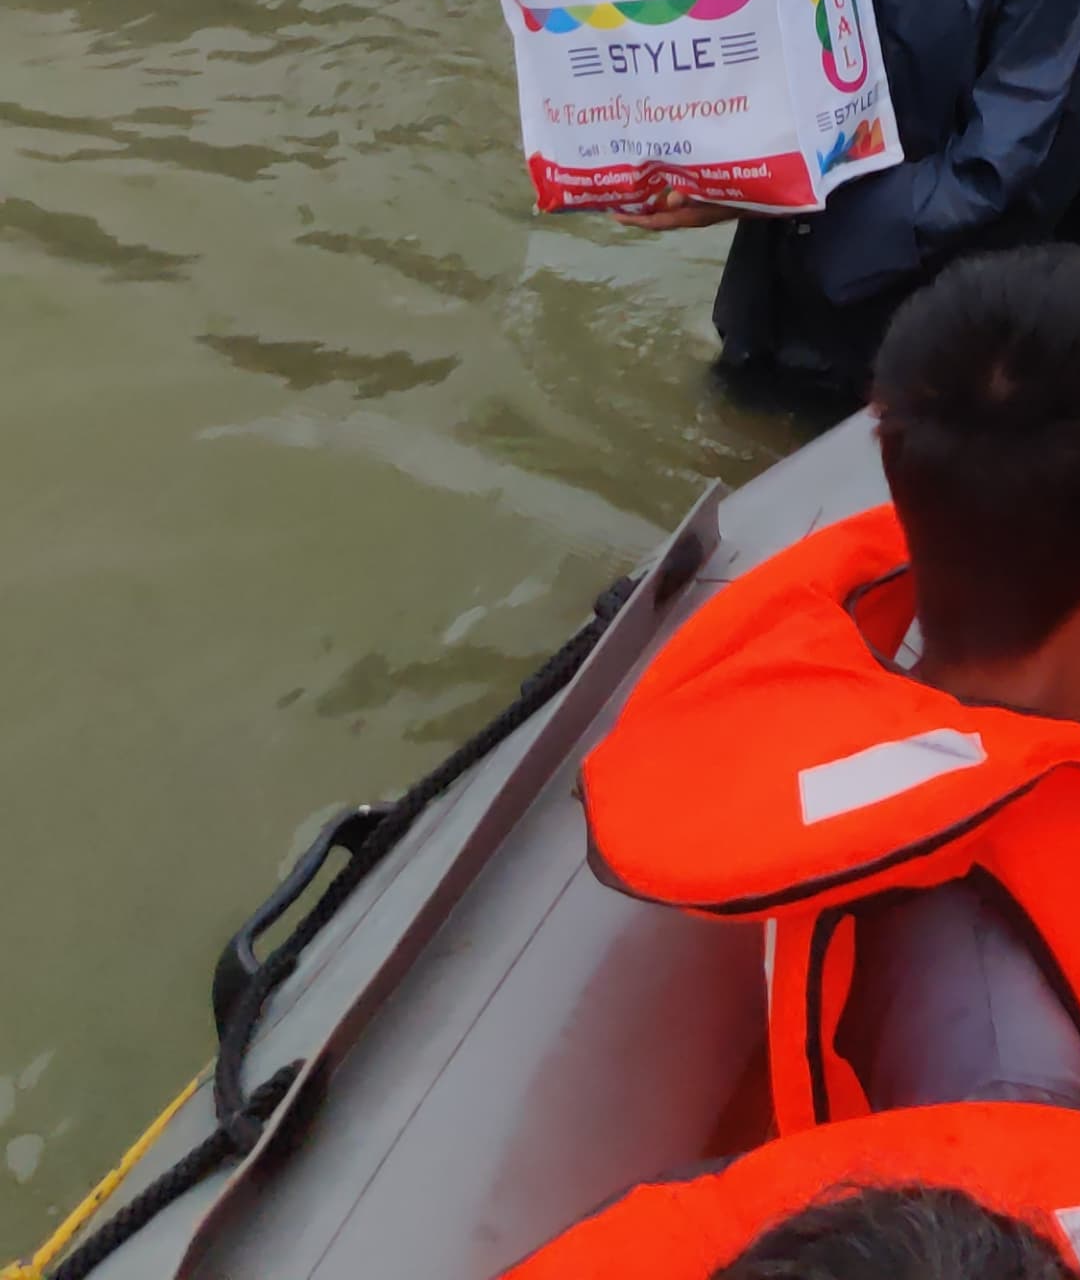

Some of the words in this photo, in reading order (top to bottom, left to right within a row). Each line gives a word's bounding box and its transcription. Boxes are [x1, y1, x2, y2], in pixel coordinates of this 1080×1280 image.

[608, 37, 715, 74] STYLE
[563, 93, 631, 129] Family
[635, 94, 750, 124] Showroom
